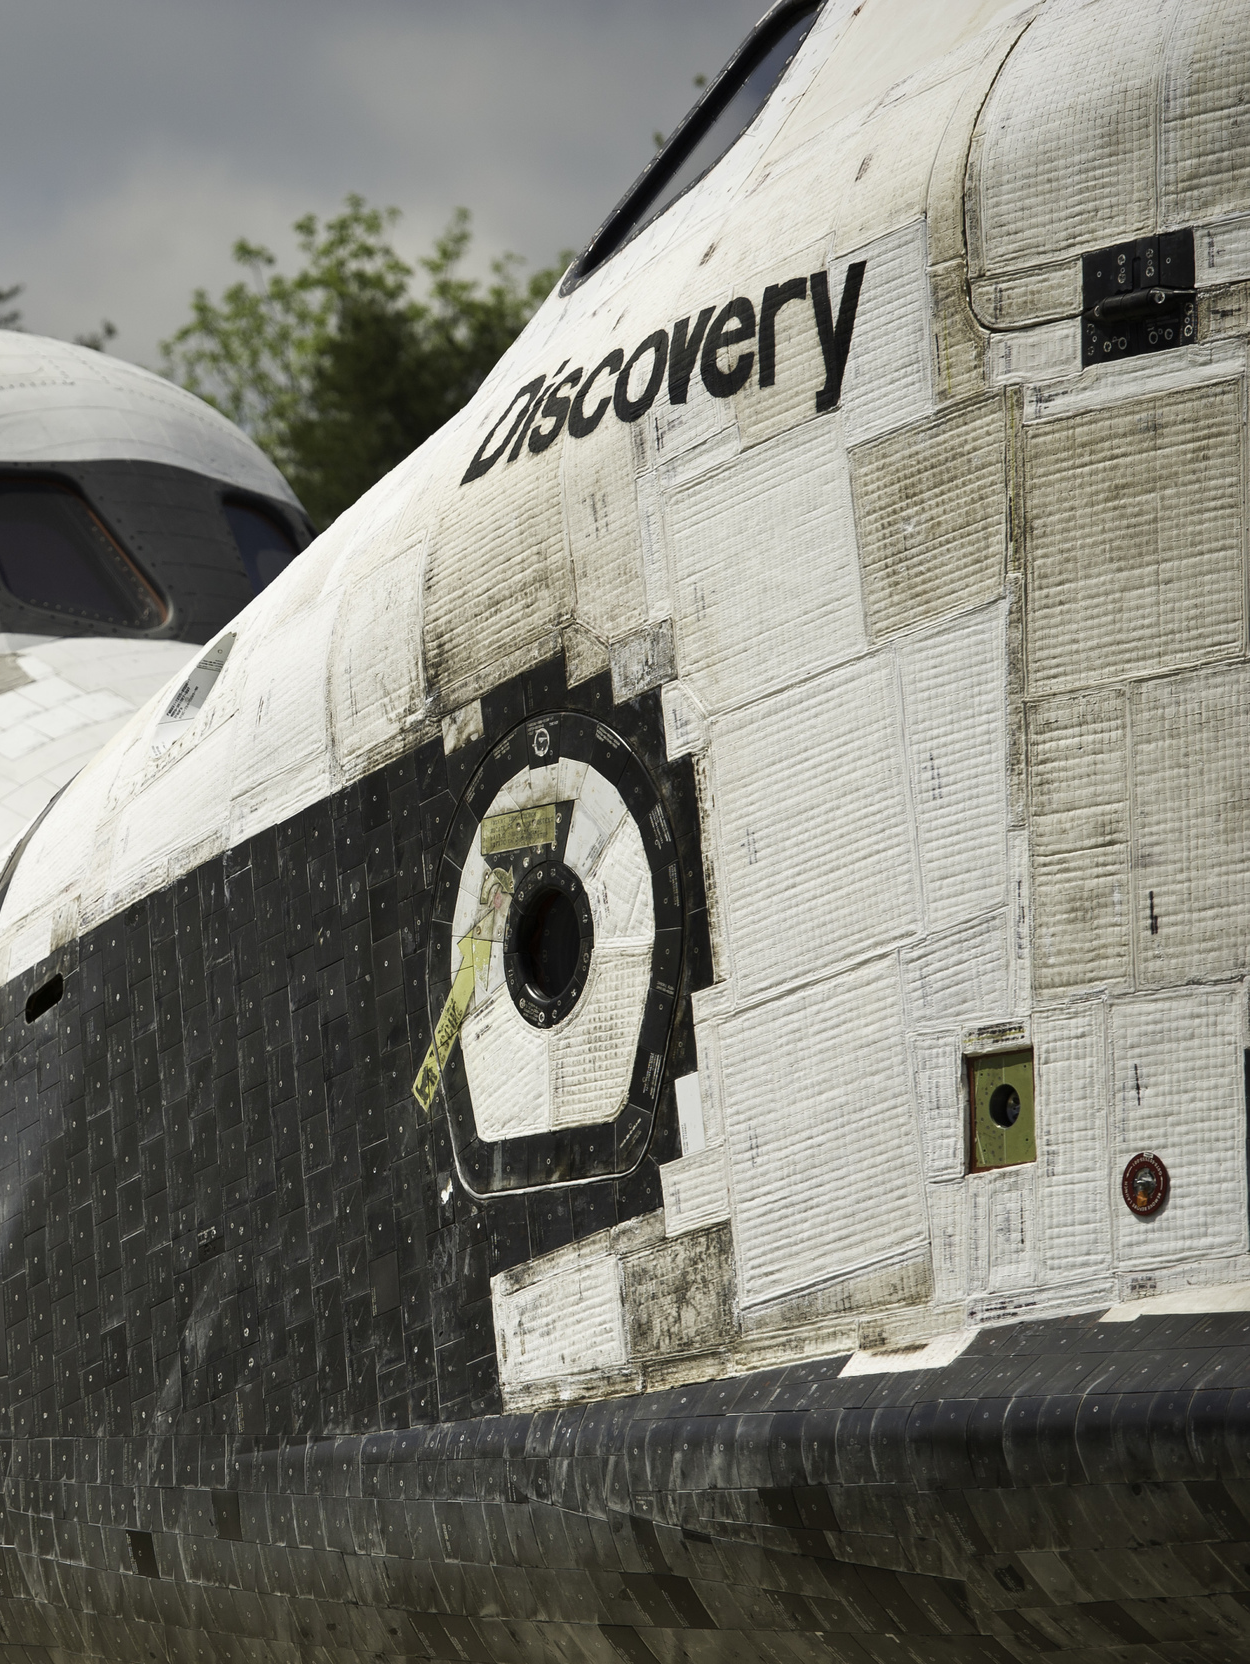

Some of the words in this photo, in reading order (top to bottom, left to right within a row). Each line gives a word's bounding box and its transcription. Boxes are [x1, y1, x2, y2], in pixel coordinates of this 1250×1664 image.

[460, 260, 867, 486] Discovery
[1124, 1181, 1133, 1205] LAUNCH
[1147, 1192, 1162, 1211] REMOVE
